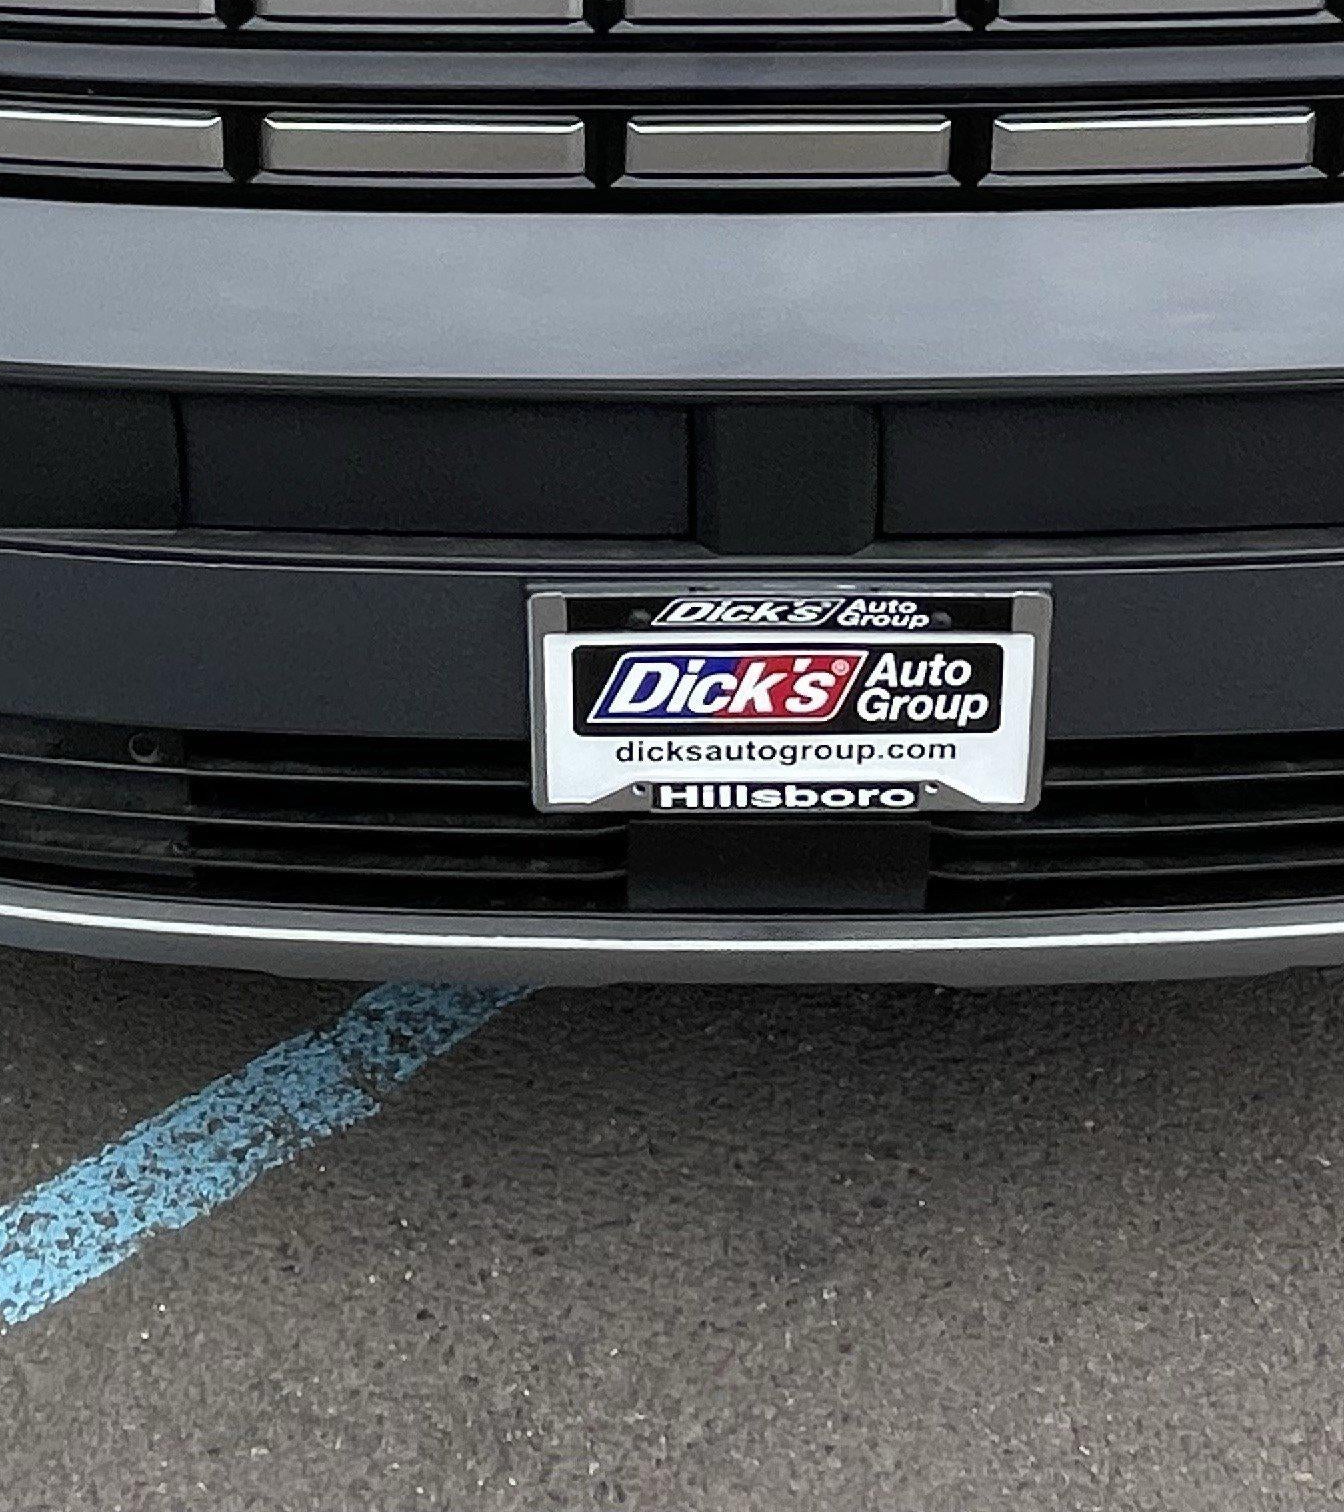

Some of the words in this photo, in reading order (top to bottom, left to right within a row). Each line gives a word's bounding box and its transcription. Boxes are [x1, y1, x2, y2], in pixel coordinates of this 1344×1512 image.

[847, 598, 918, 614] Auto
[836, 613, 930, 629] Group
[865, 652, 972, 688] Auto
[856, 688, 990, 727] Group
[615, 740, 958, 766] dicksautogroup.com
[659, 784, 918, 809] Hillsboro
